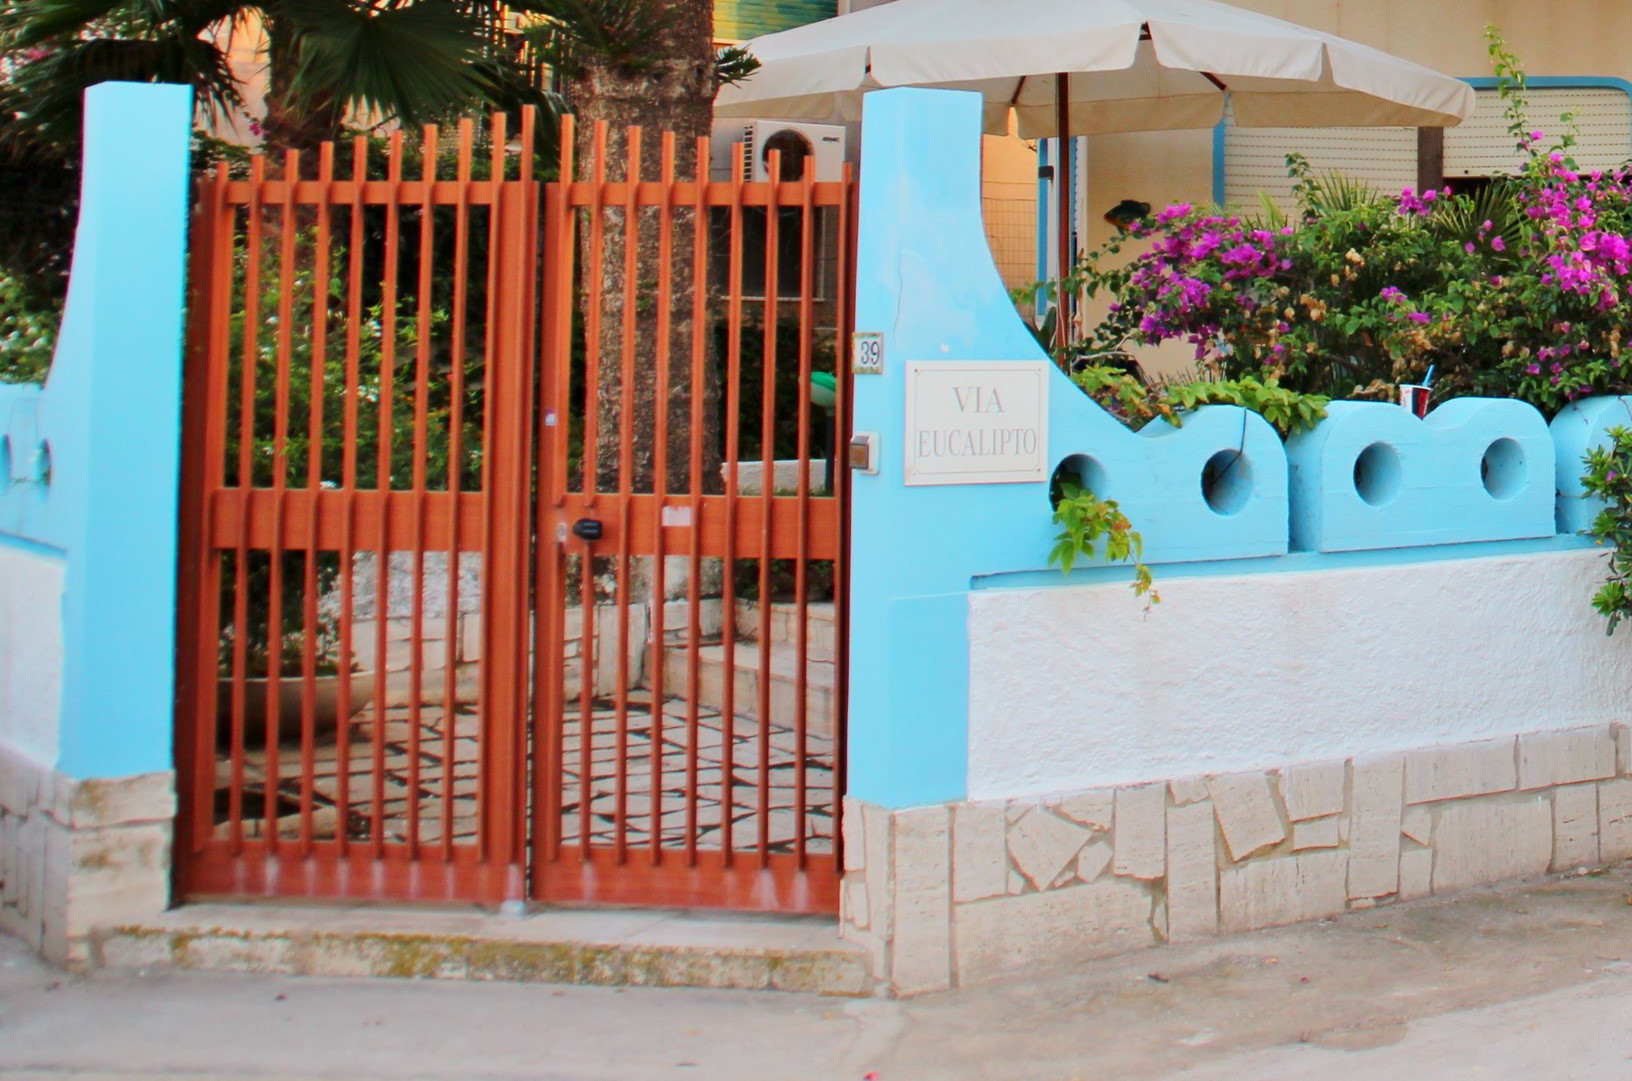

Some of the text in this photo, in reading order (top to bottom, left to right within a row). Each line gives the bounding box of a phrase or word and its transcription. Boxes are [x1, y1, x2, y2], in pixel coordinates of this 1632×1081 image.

[861, 341, 880, 365] 39
[953, 386, 1004, 413] VIA
[919, 428, 1037, 458] EUCALIPTO
